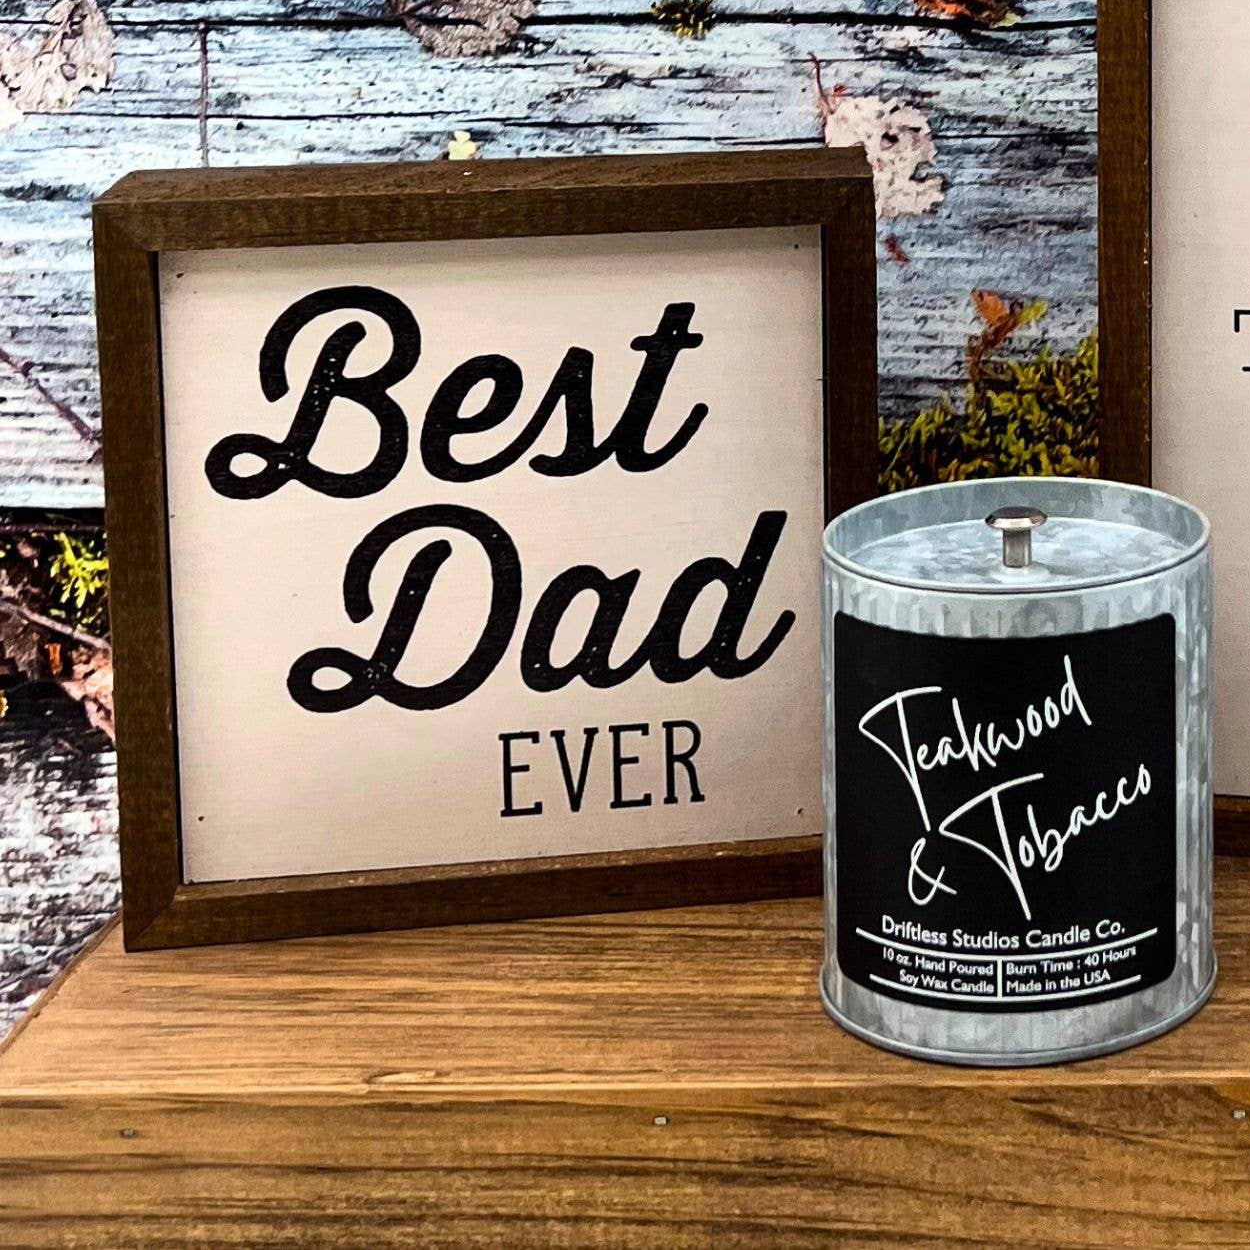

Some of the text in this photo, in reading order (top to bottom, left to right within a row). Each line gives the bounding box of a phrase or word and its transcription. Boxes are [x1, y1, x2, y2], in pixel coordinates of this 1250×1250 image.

[204, 285, 709, 501] Best
[286, 503, 797, 714] Dad
[498, 719, 706, 818] EVER
[858, 654, 1093, 832] Teakwood
[907, 763, 1151, 921] & Tobacco
[882, 915, 1126, 949] Driftless Studios Candle Co.
[883, 947, 994, 976] 10 oz. Hand Poured
[1006, 962, 1037, 976] Burn
[1040, 958, 1074, 973] Time
[1084, 953, 1100, 967] 40
[900, 969, 995, 993] Soy Wax Candle
[1006, 969, 1111, 993] Made in the USA
